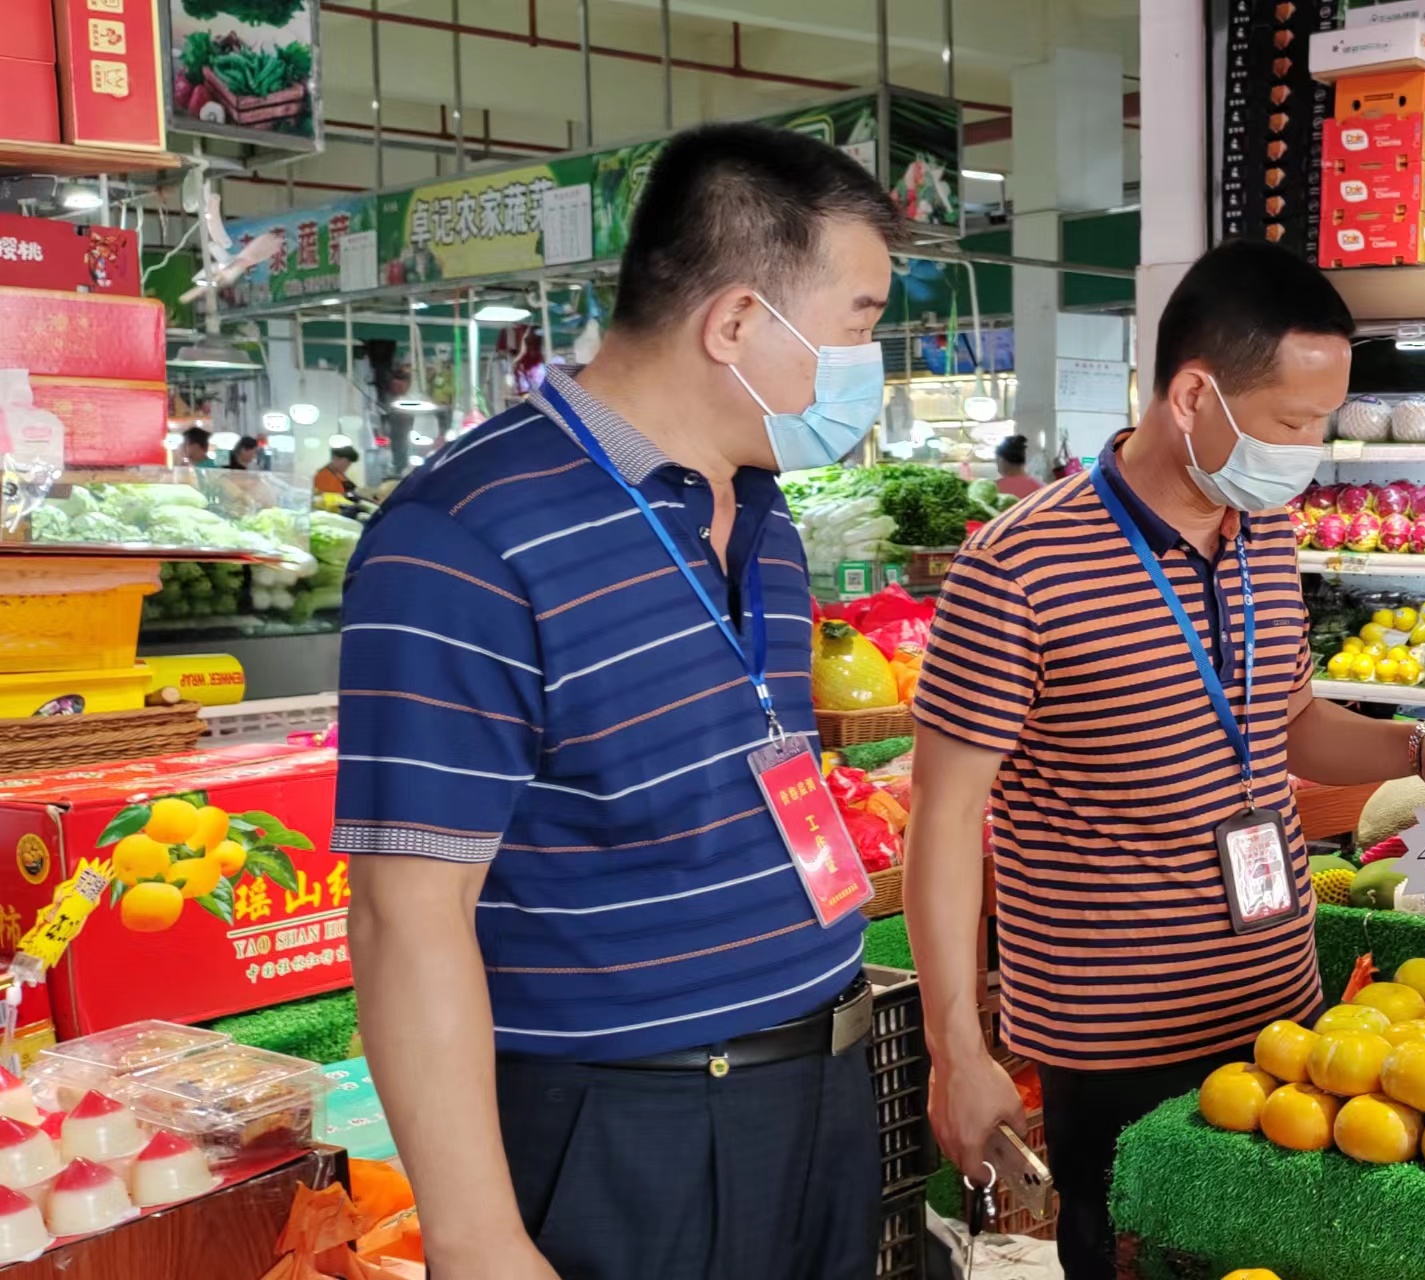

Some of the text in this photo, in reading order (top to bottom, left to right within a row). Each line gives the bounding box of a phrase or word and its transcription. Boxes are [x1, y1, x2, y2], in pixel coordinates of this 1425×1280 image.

[410, 177, 555, 248] 卓记农家蔬菜
[233, 935, 271, 960] YAO
[275, 924, 320, 951] SHAN
